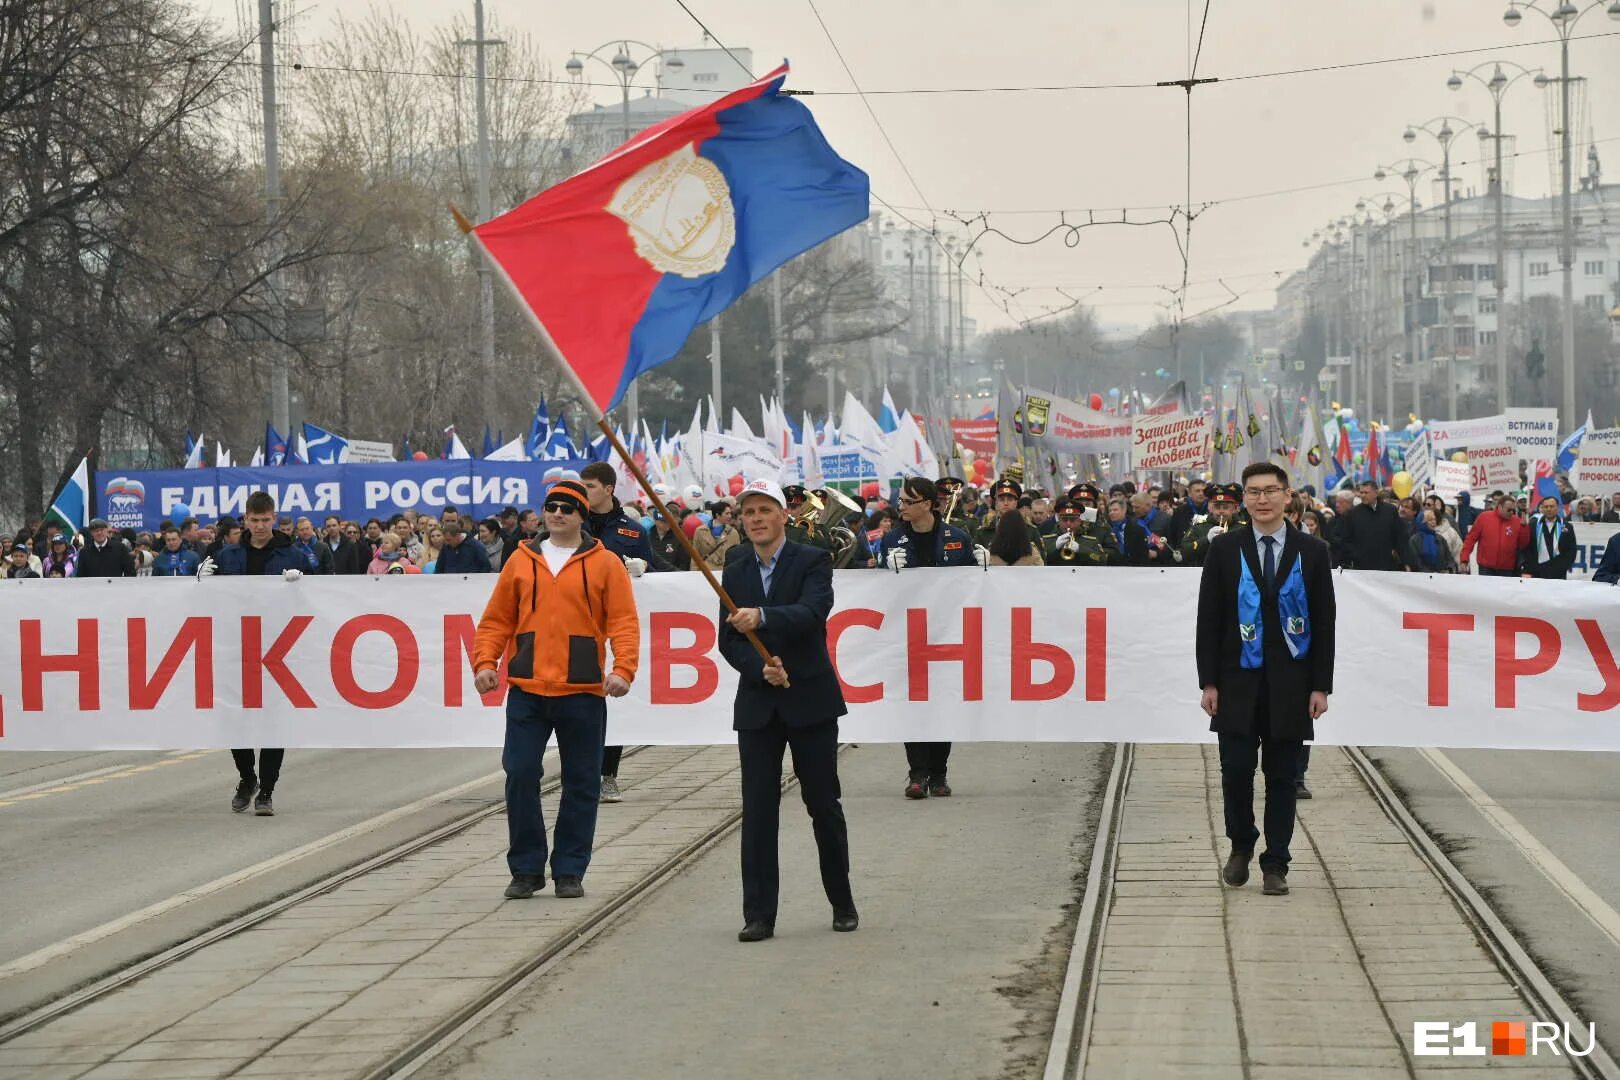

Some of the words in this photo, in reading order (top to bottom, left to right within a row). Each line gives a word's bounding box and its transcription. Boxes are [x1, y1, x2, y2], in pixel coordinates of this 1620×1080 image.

[1134, 417, 1205, 445] Защитим
[1508, 421, 1547, 430] ВСТУПАЙ
[1548, 422, 1553, 430] В
[1588, 431, 1620, 441] ПРОФСО
[1147, 431, 1198, 453] права
[1468, 446, 1512, 459] ПРОФСОЮЗ
[1471, 465, 1488, 486] ЗА
[365, 476, 528, 509] РОССИЯ
[108, 513, 143, 521] ЕДИНАЯ
[650, 607, 1107, 704] ВСНЫ
